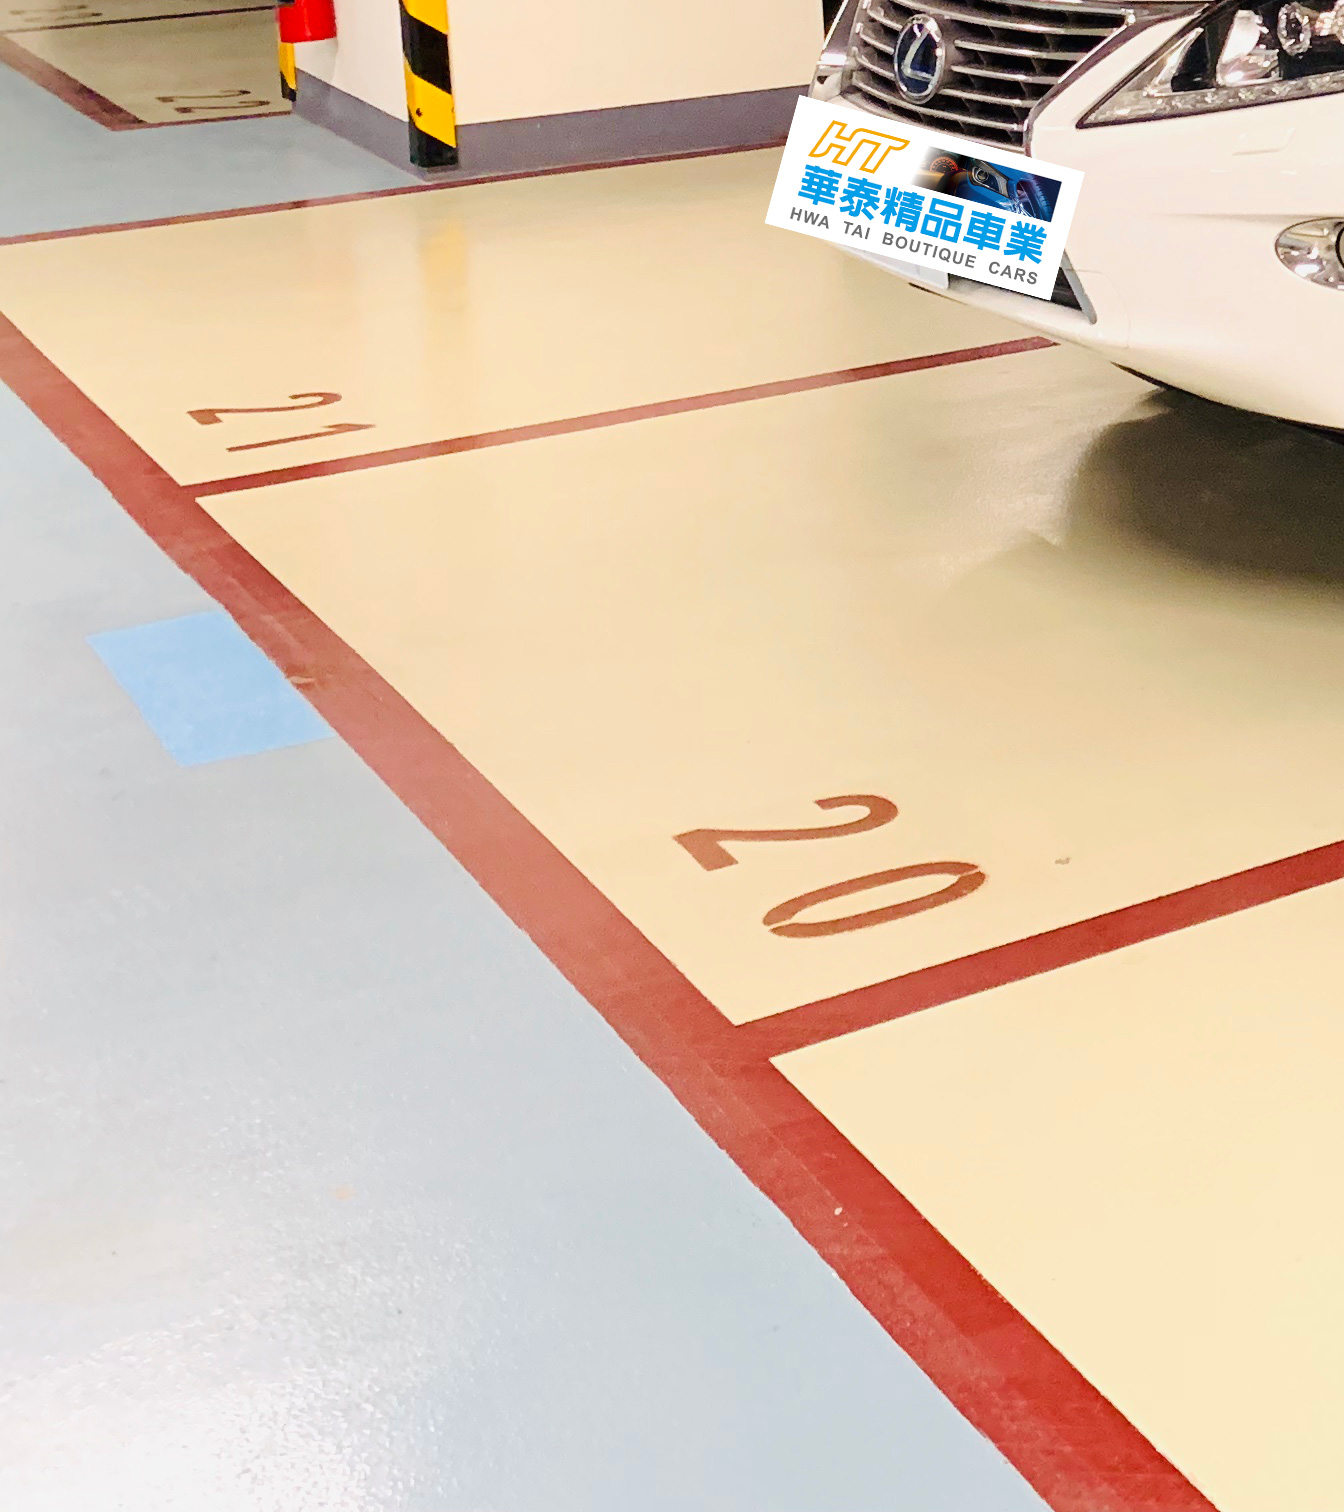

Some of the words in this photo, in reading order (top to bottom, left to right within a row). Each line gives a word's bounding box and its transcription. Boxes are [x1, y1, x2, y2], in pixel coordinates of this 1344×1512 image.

[155, 89, 270, 114] 22
[186, 391, 376, 452] 21
[673, 794, 987, 938] 20
